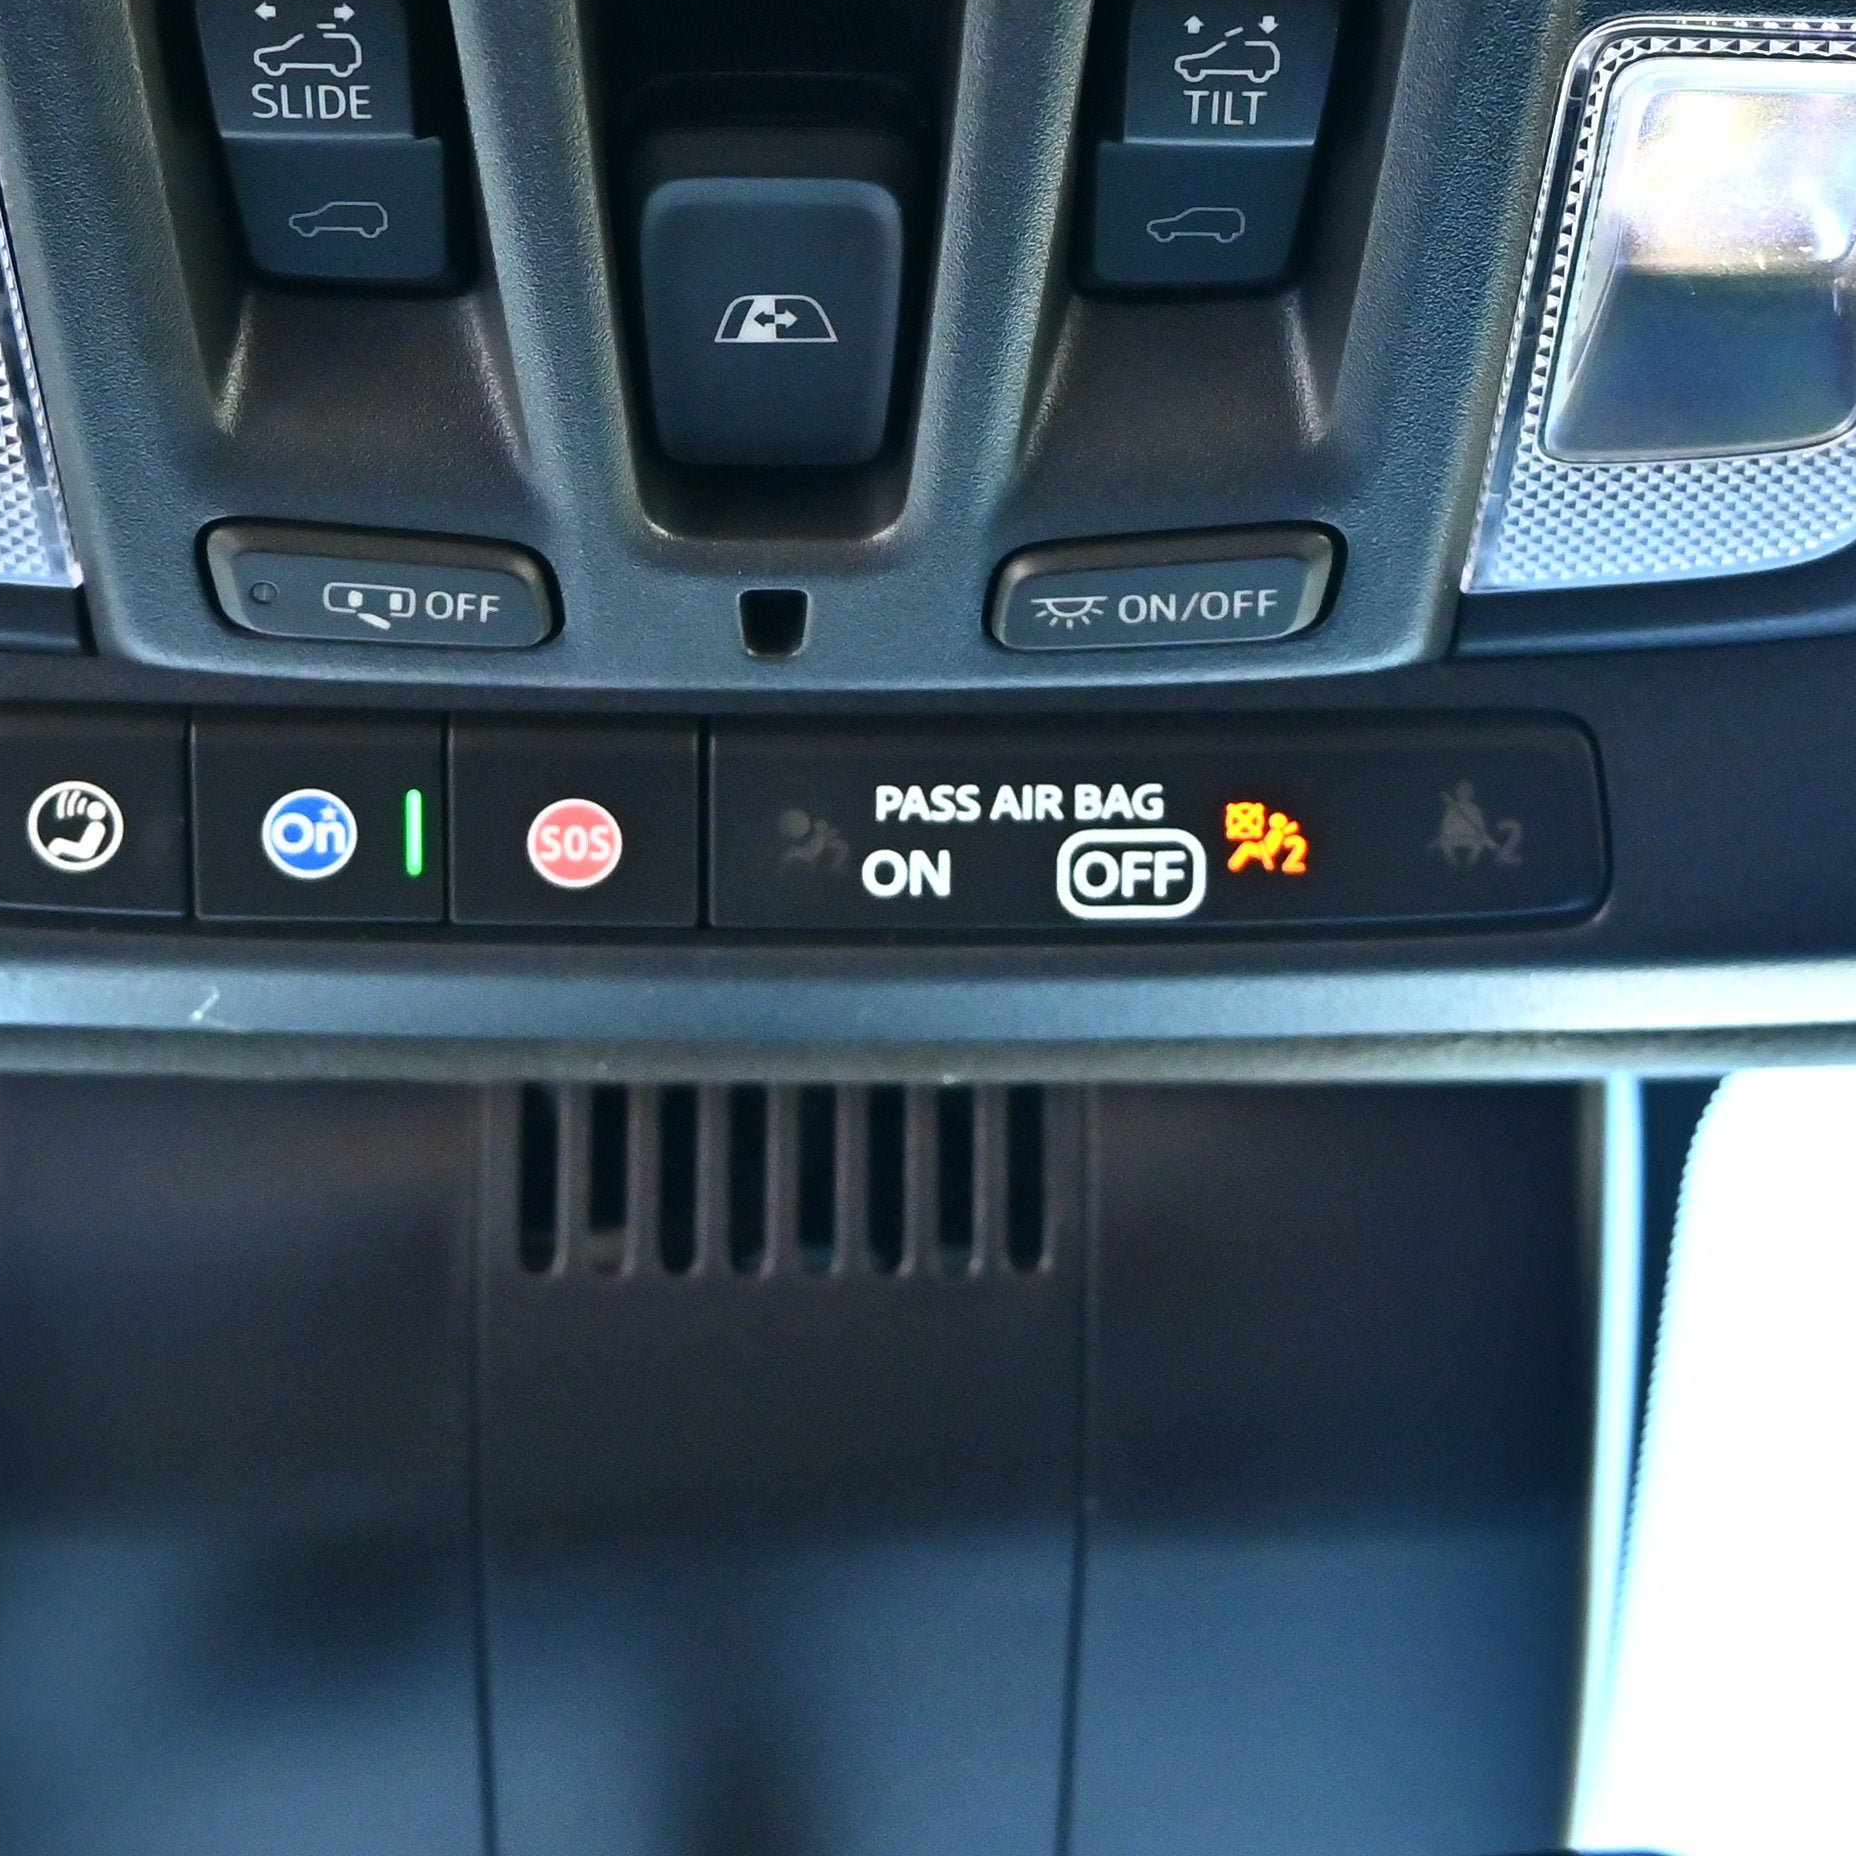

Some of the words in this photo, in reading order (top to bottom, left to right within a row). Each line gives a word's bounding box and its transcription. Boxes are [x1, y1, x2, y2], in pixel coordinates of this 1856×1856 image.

[250, 82, 373, 121] SLIDE
[1182, 89, 1269, 126] TILT
[425, 590, 501, 624] OFF
[1117, 588, 1279, 625] ON/OFF
[874, 784, 982, 822] PASS
[989, 784, 1064, 821] AIR
[1073, 783, 1166, 821] BAG
[539, 823, 612, 863] SOS
[860, 848, 952, 899] ON
[1072, 849, 1187, 899] OFF
